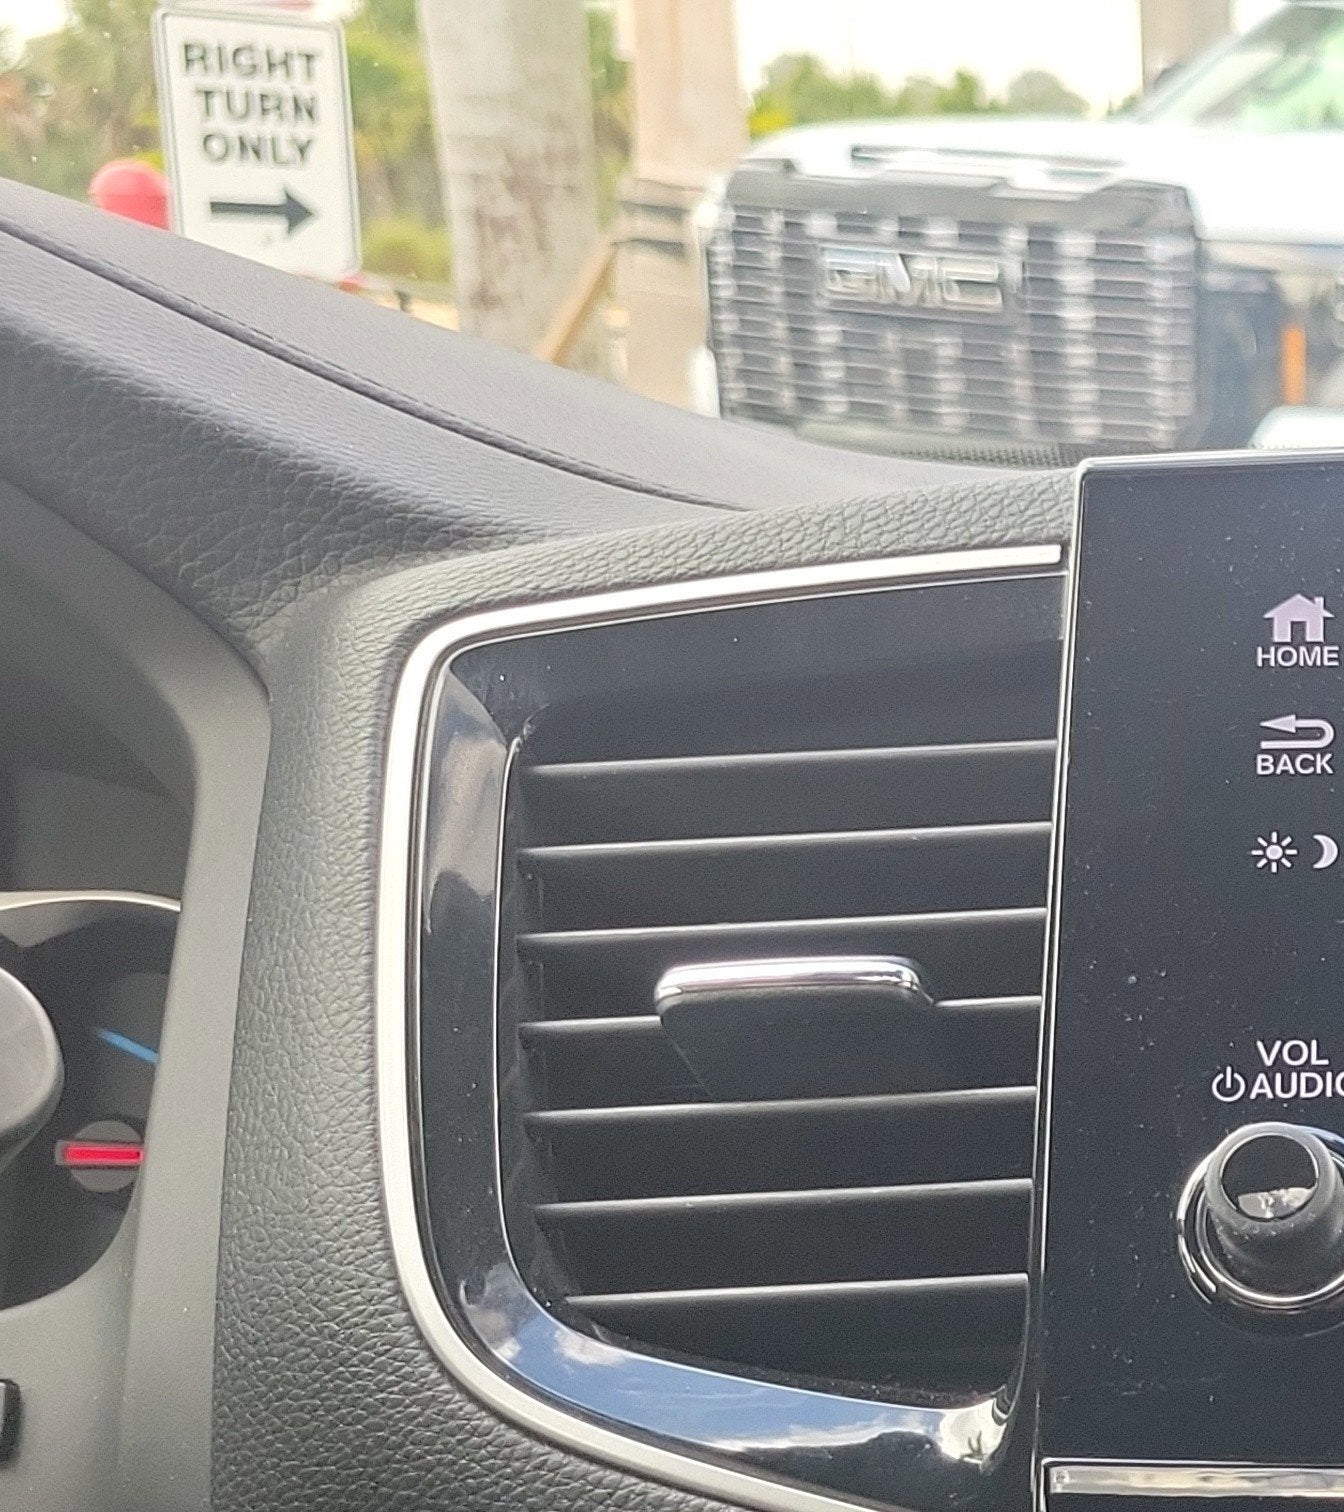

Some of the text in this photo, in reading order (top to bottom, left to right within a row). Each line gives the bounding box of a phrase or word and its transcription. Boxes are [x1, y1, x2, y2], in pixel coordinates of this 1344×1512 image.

[183, 43, 317, 79] RIGHT
[195, 87, 316, 121] TURN
[202, 133, 314, 165] ONLY
[1255, 646, 1340, 667] HOME
[1255, 753, 1334, 775] BACK
[1255, 1039, 1329, 1066] VOL
